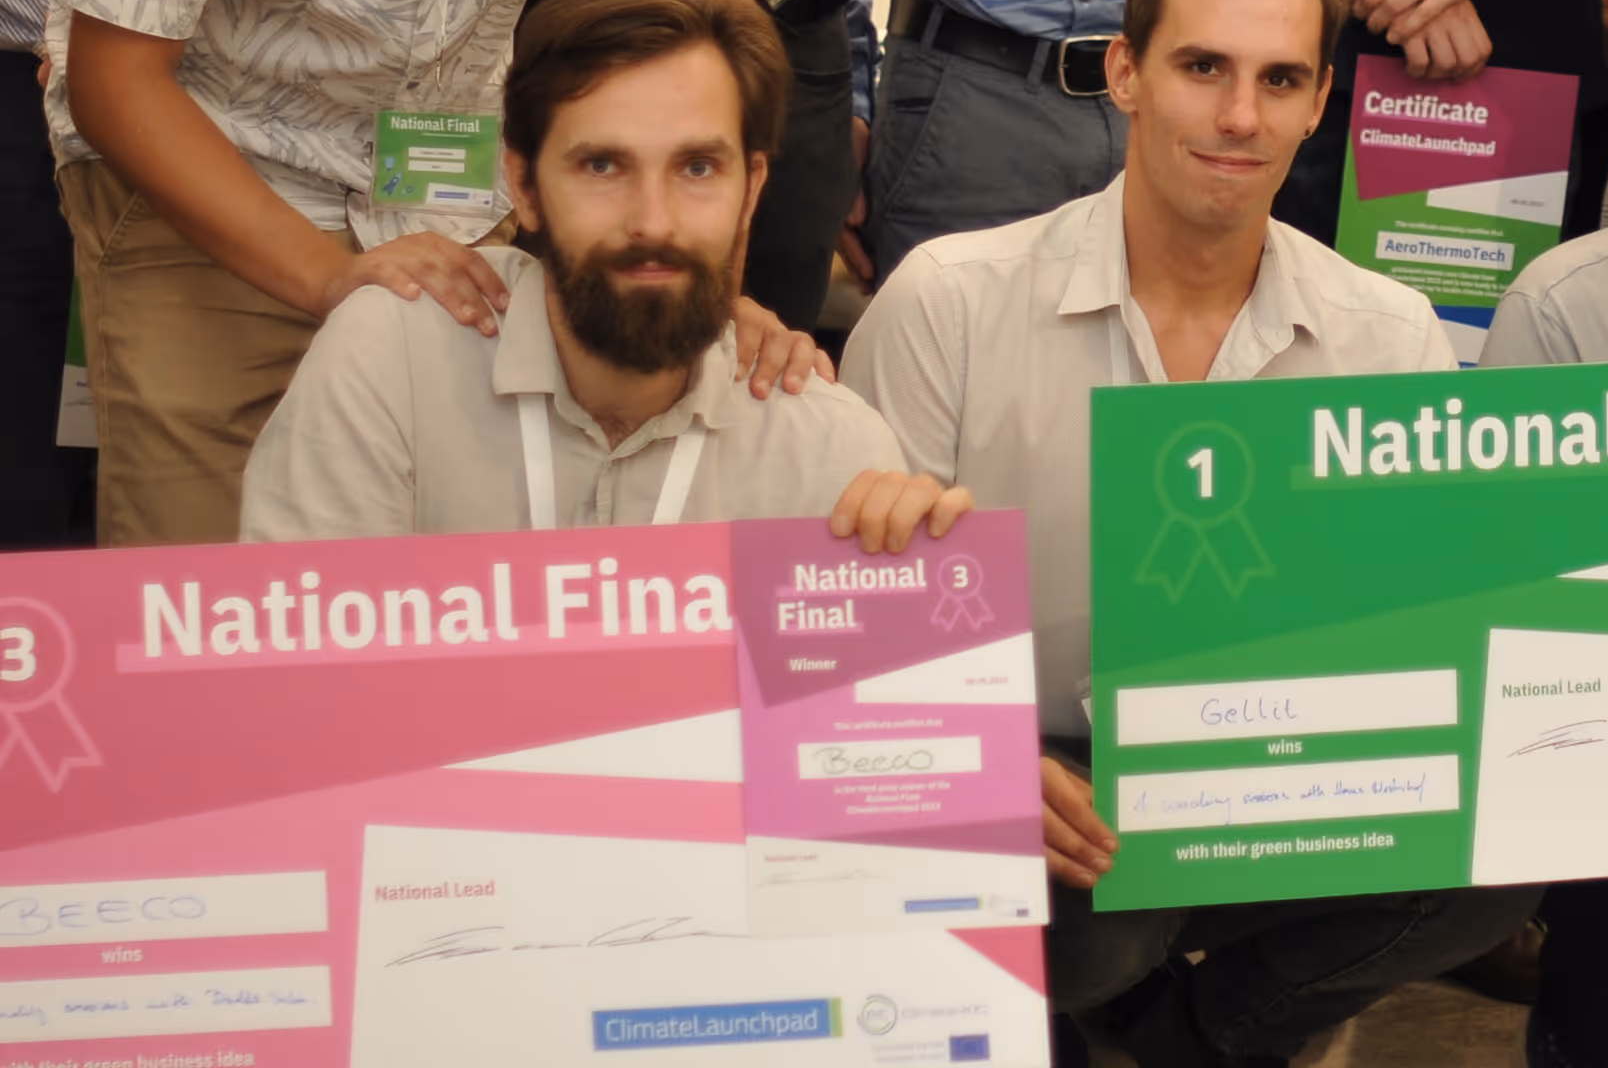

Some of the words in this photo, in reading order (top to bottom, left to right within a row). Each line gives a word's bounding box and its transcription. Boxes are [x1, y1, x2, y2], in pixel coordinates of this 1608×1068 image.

[1364, 91, 1490, 125] Certificate
[391, 117, 444, 131] National
[447, 119, 480, 133] Final
[1360, 129, 1496, 156] ClimateLaunchpad
[1385, 238, 1505, 263] AeroThermoTech
[1186, 448, 1214, 498] 1
[795, 559, 927, 593] National
[952, 566, 969, 588] 3
[142, 564, 519, 658] National
[545, 557, 733, 638] Fina
[778, 599, 857, 632] Final
[0, 627, 36, 681] 3
[789, 657, 837, 672] Winner
[1502, 679, 1562, 698] National
[1568, 678, 1601, 694] Lead
[1268, 739, 1303, 755] wins
[1176, 843, 1209, 860] with
[1213, 841, 1248, 858] their
[1250, 842, 1292, 861] green
[1296, 835, 1360, 854] business
[1363, 832, 1394, 849] idea
[375, 881, 449, 902] National
[453, 880, 496, 899] Lead
[0, 897, 207, 936] BEECO
[101, 947, 143, 964] wins
[606, 1009, 818, 1042] ClimateLaunchpad
[217, 1050, 255, 1067] idea
